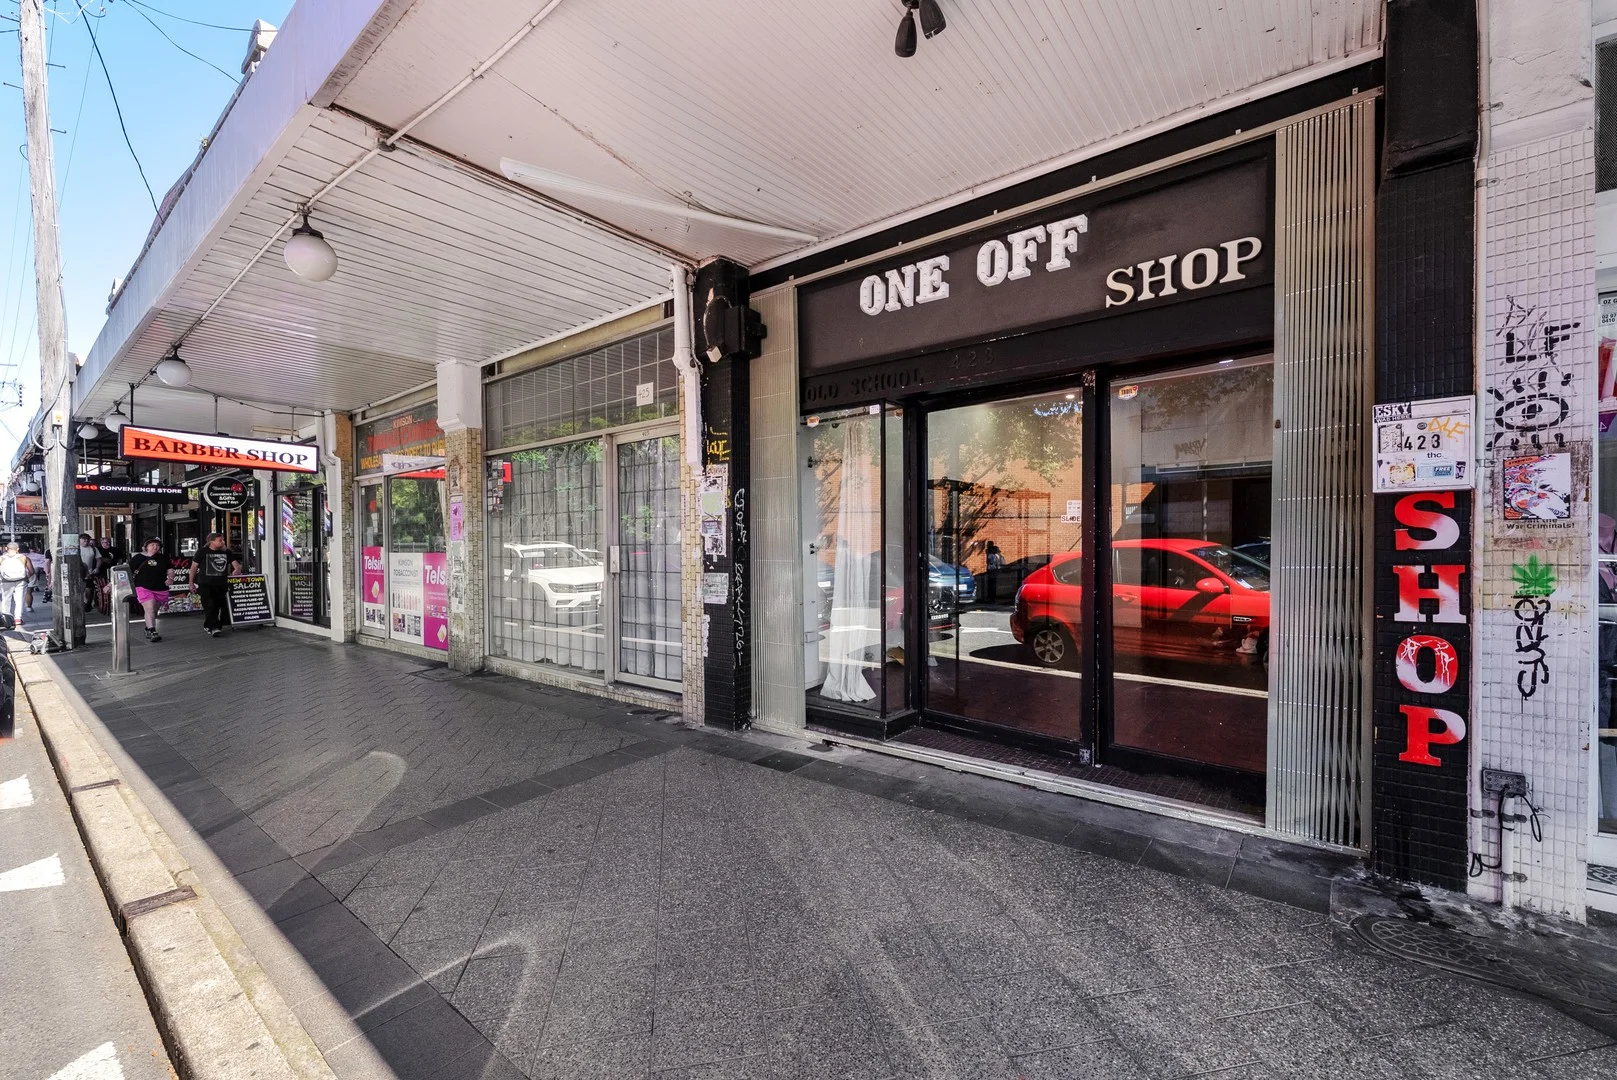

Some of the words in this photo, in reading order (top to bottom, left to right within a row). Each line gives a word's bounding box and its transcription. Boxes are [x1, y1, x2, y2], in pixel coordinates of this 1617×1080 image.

[859, 255, 950, 316] ONE
[976, 214, 1089, 287] OFF
[1105, 236, 1262, 309] SHOP
[804, 384, 840, 402] OLD
[850, 368, 925, 395] SCHOOL
[1375, 402, 1410, 417] ESKY
[132, 437, 240, 459] BARBER
[246, 449, 308, 466] SHOP
[1403, 433, 1441, 450] 423
[100, 485, 156, 493] CONVENIENCE
[233, 582, 261, 590] SALON
[1393, 490, 1466, 767] SHOP
